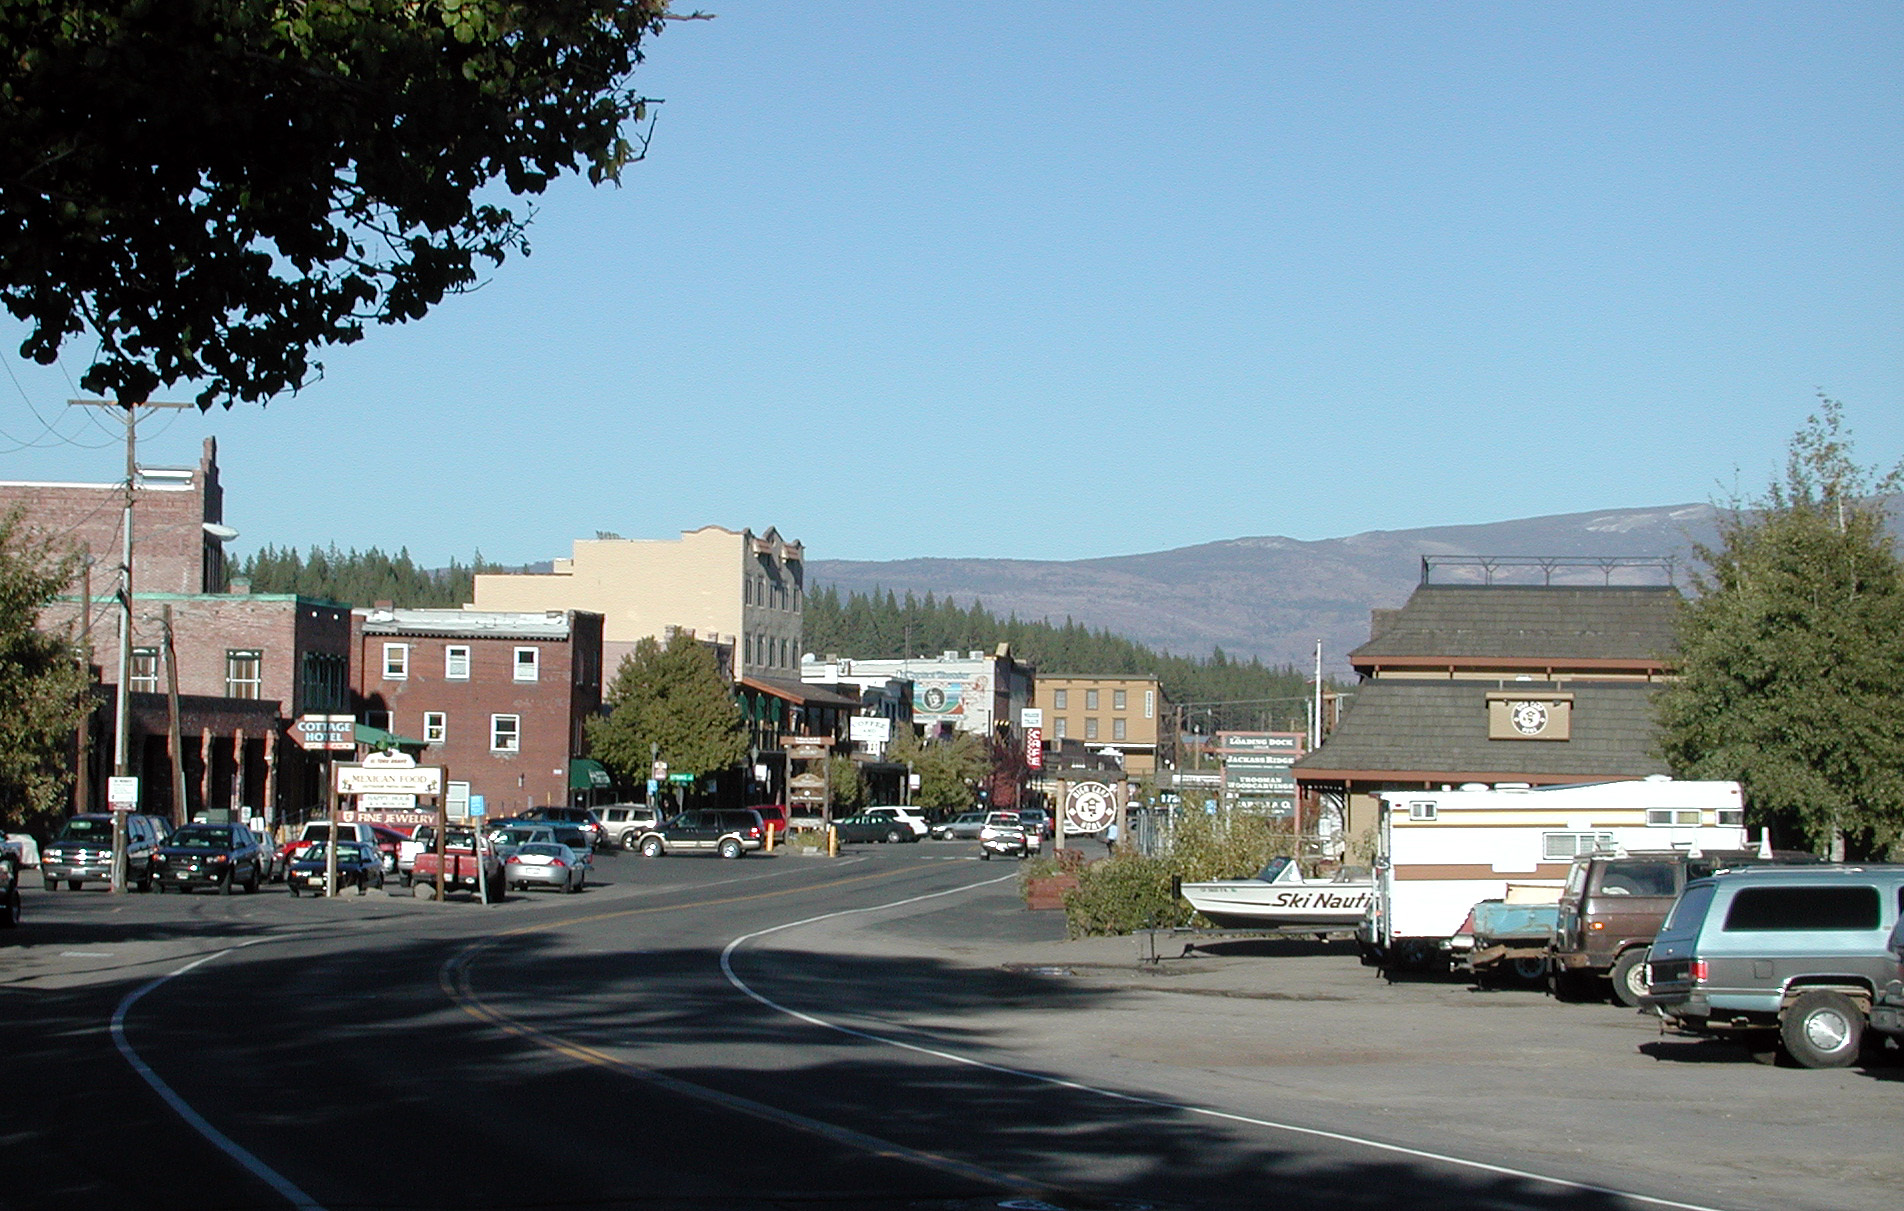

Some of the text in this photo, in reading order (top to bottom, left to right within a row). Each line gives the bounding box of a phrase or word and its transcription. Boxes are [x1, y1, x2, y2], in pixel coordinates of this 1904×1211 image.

[298, 721, 351, 731] COTTAGE
[305, 732, 343, 741] HOTEL
[1031, 730, 1041, 766] CAFE
[1266, 756, 1295, 764] RIDGE
[352, 775, 428, 783] MEXICAN FOOD
[1227, 782, 1295, 790] WOODCARVINGS
[1072, 785, 1110, 799] HIGH CAMP
[357, 813, 383, 823] FINE
[384, 814, 435, 823] JEWELRY
[1080, 821, 1102, 831] HOME
[1276, 893, 1313, 909] Ski
